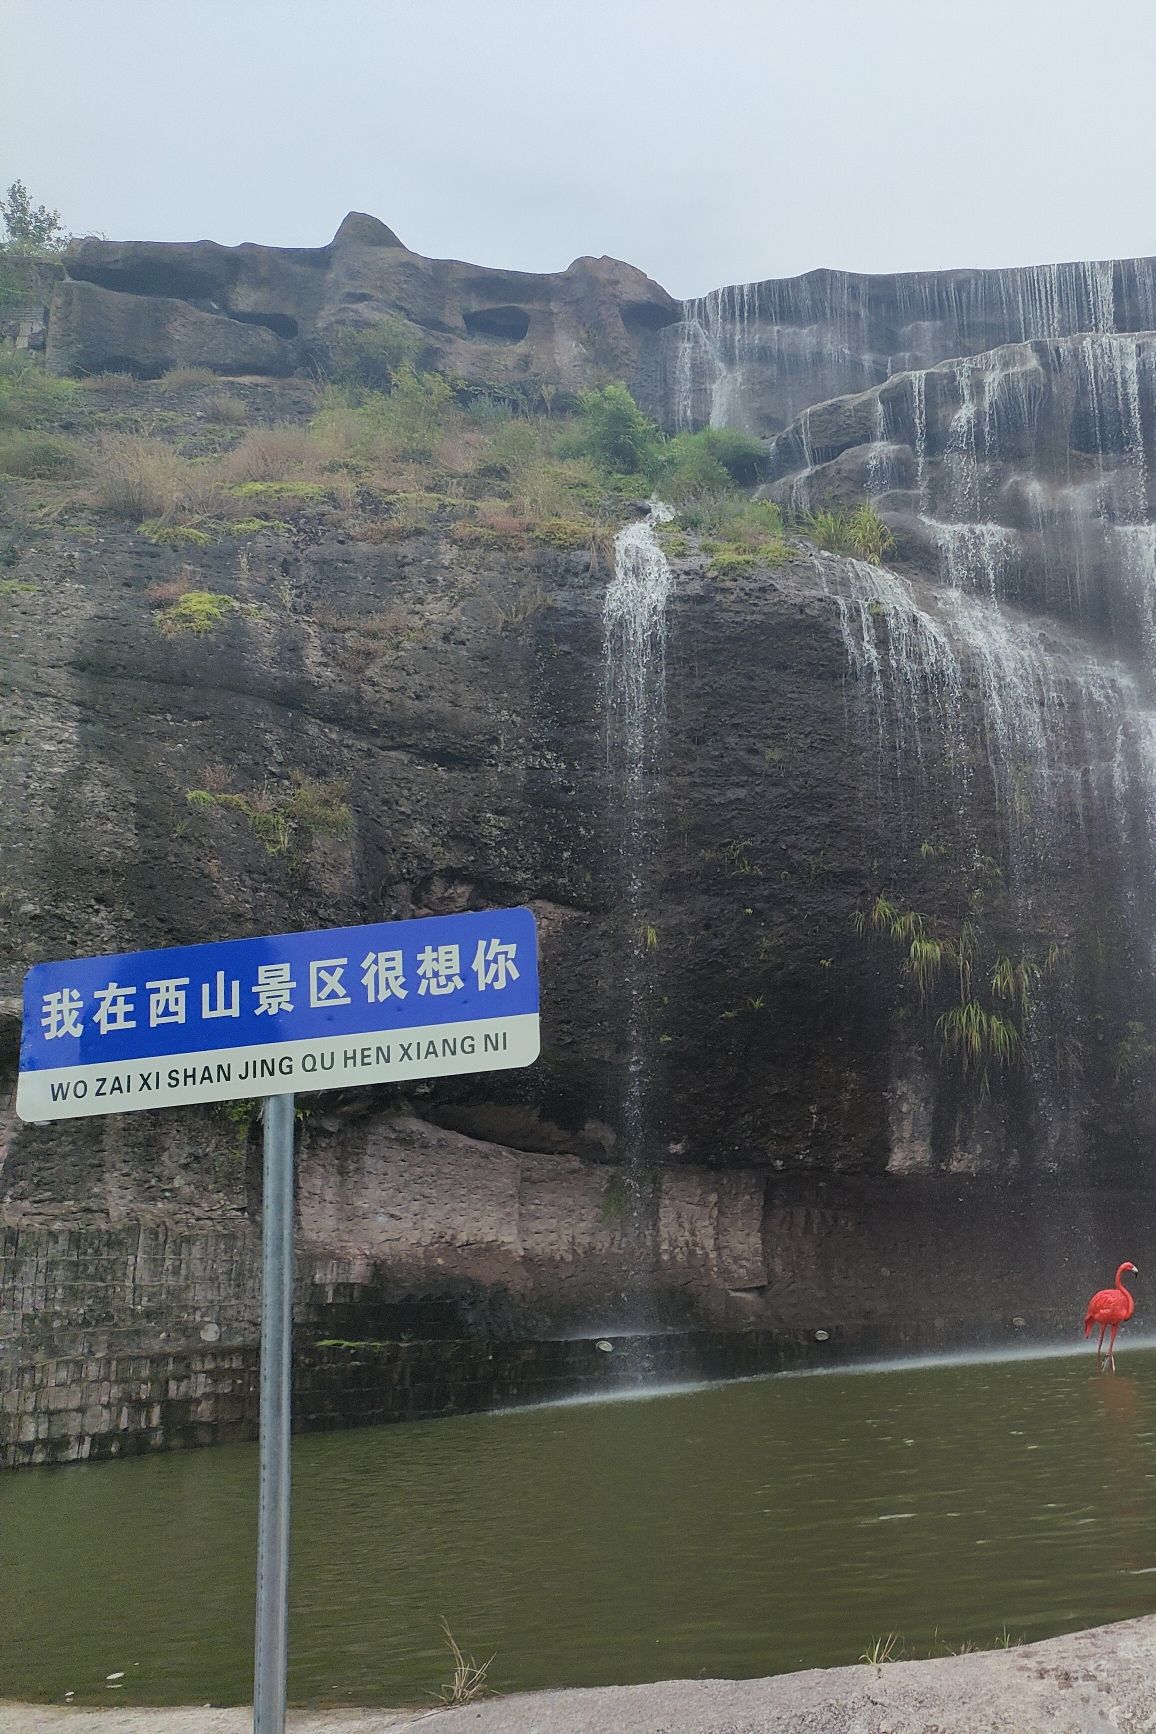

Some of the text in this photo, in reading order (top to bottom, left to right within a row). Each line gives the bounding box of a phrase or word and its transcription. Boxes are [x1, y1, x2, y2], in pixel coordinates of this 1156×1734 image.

[41, 938, 520, 1041] 我在西山景区很想你
[50, 1031, 507, 1102] WO ZAI XI SHAN JING QU HEN XIANG NI
